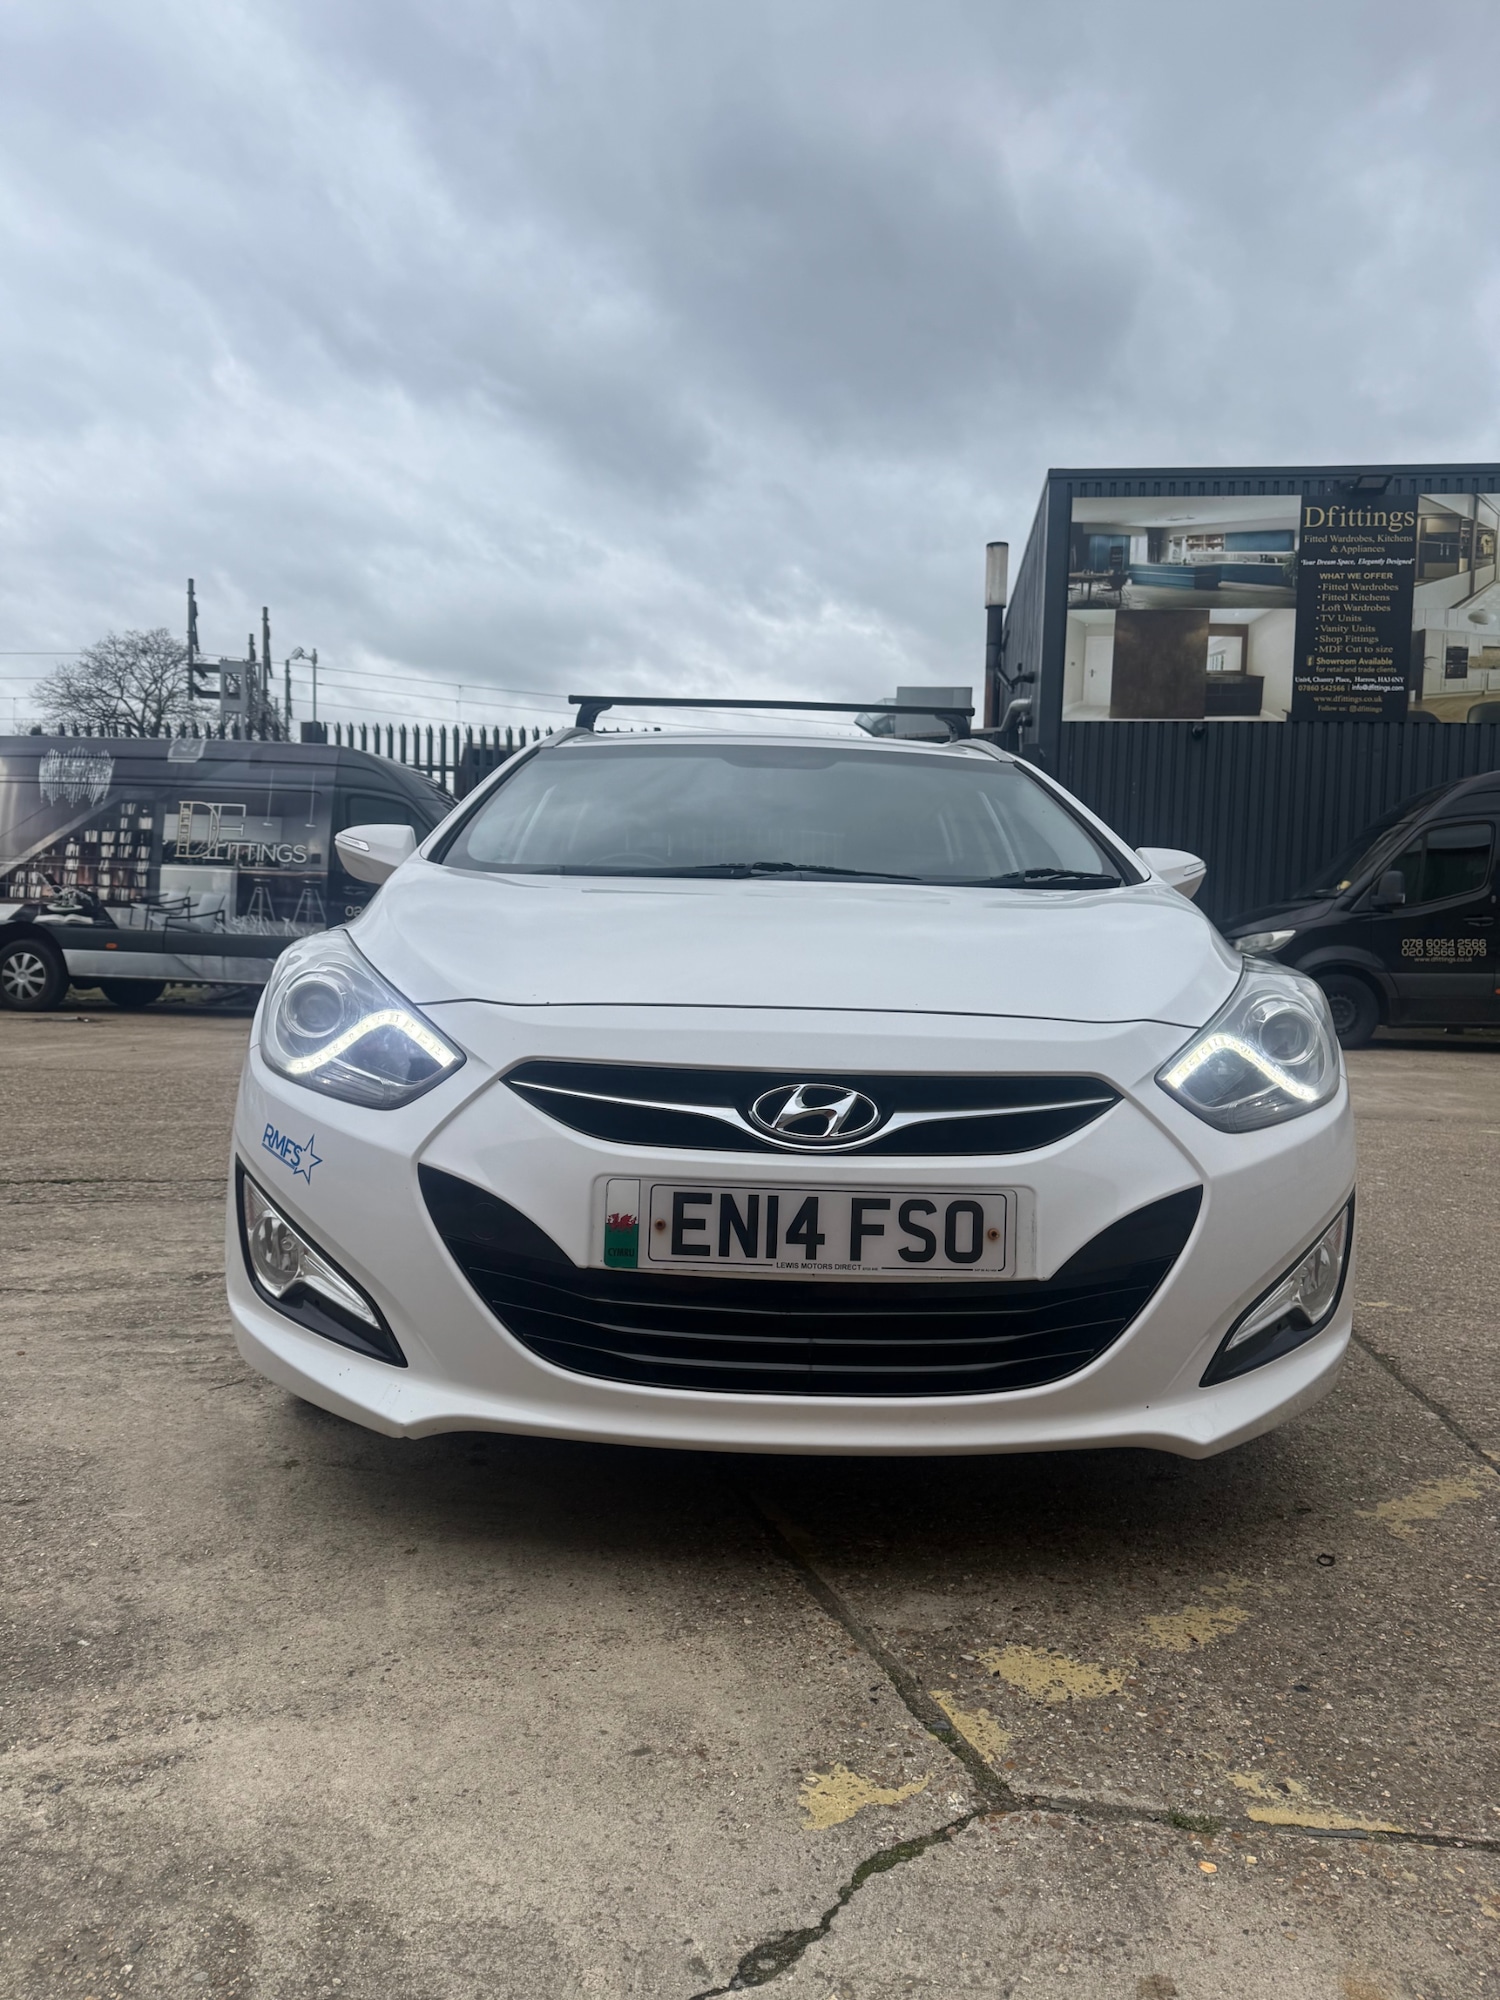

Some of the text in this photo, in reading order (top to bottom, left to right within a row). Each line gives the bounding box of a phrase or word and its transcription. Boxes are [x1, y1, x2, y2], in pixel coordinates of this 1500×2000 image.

[1304, 505, 1415, 532] Dfittings
[1304, 534, 1413, 544] Fitted Wardrobes, Kitchens
[1330, 545, 1385, 555] & Appliances
[1317, 558, 1336, 566] Dream
[1358, 558, 1385, 567] Elegantly
[1322, 583, 1399, 591] Fitted Wardrobes
[1321, 593, 1390, 601] Fitted Kitchens
[1321, 604, 1391, 612] Loft Wardrobes
[1321, 614, 1362, 622] TV Units
[1320, 625, 1349, 633] Vanity
[1319, 635, 1379, 644] Shop Fittings
[1318, 645, 1343, 653] MDF
[1345, 645, 1362, 653] Cut
[1376, 645, 1393, 653] size
[1316, 656, 1393, 665] Showroom Available
[1298, 684, 1319, 692] 07860
[1352, 683, 1404, 692] info@dfittings.com
[1313, 695, 1383, 704] www.dfittings.co.uk
[1402, 939, 1487, 948] 078 6054 2566
[1401, 947, 1487, 956] 020 3566 6079
[262, 1123, 302, 1167] RMFS
[671, 1191, 825, 1260] EN14
[608, 1247, 635, 1257] CYMRU
[801, 1262, 833, 1270] MOTORS
[834, 1263, 862, 1271] DIRECT
